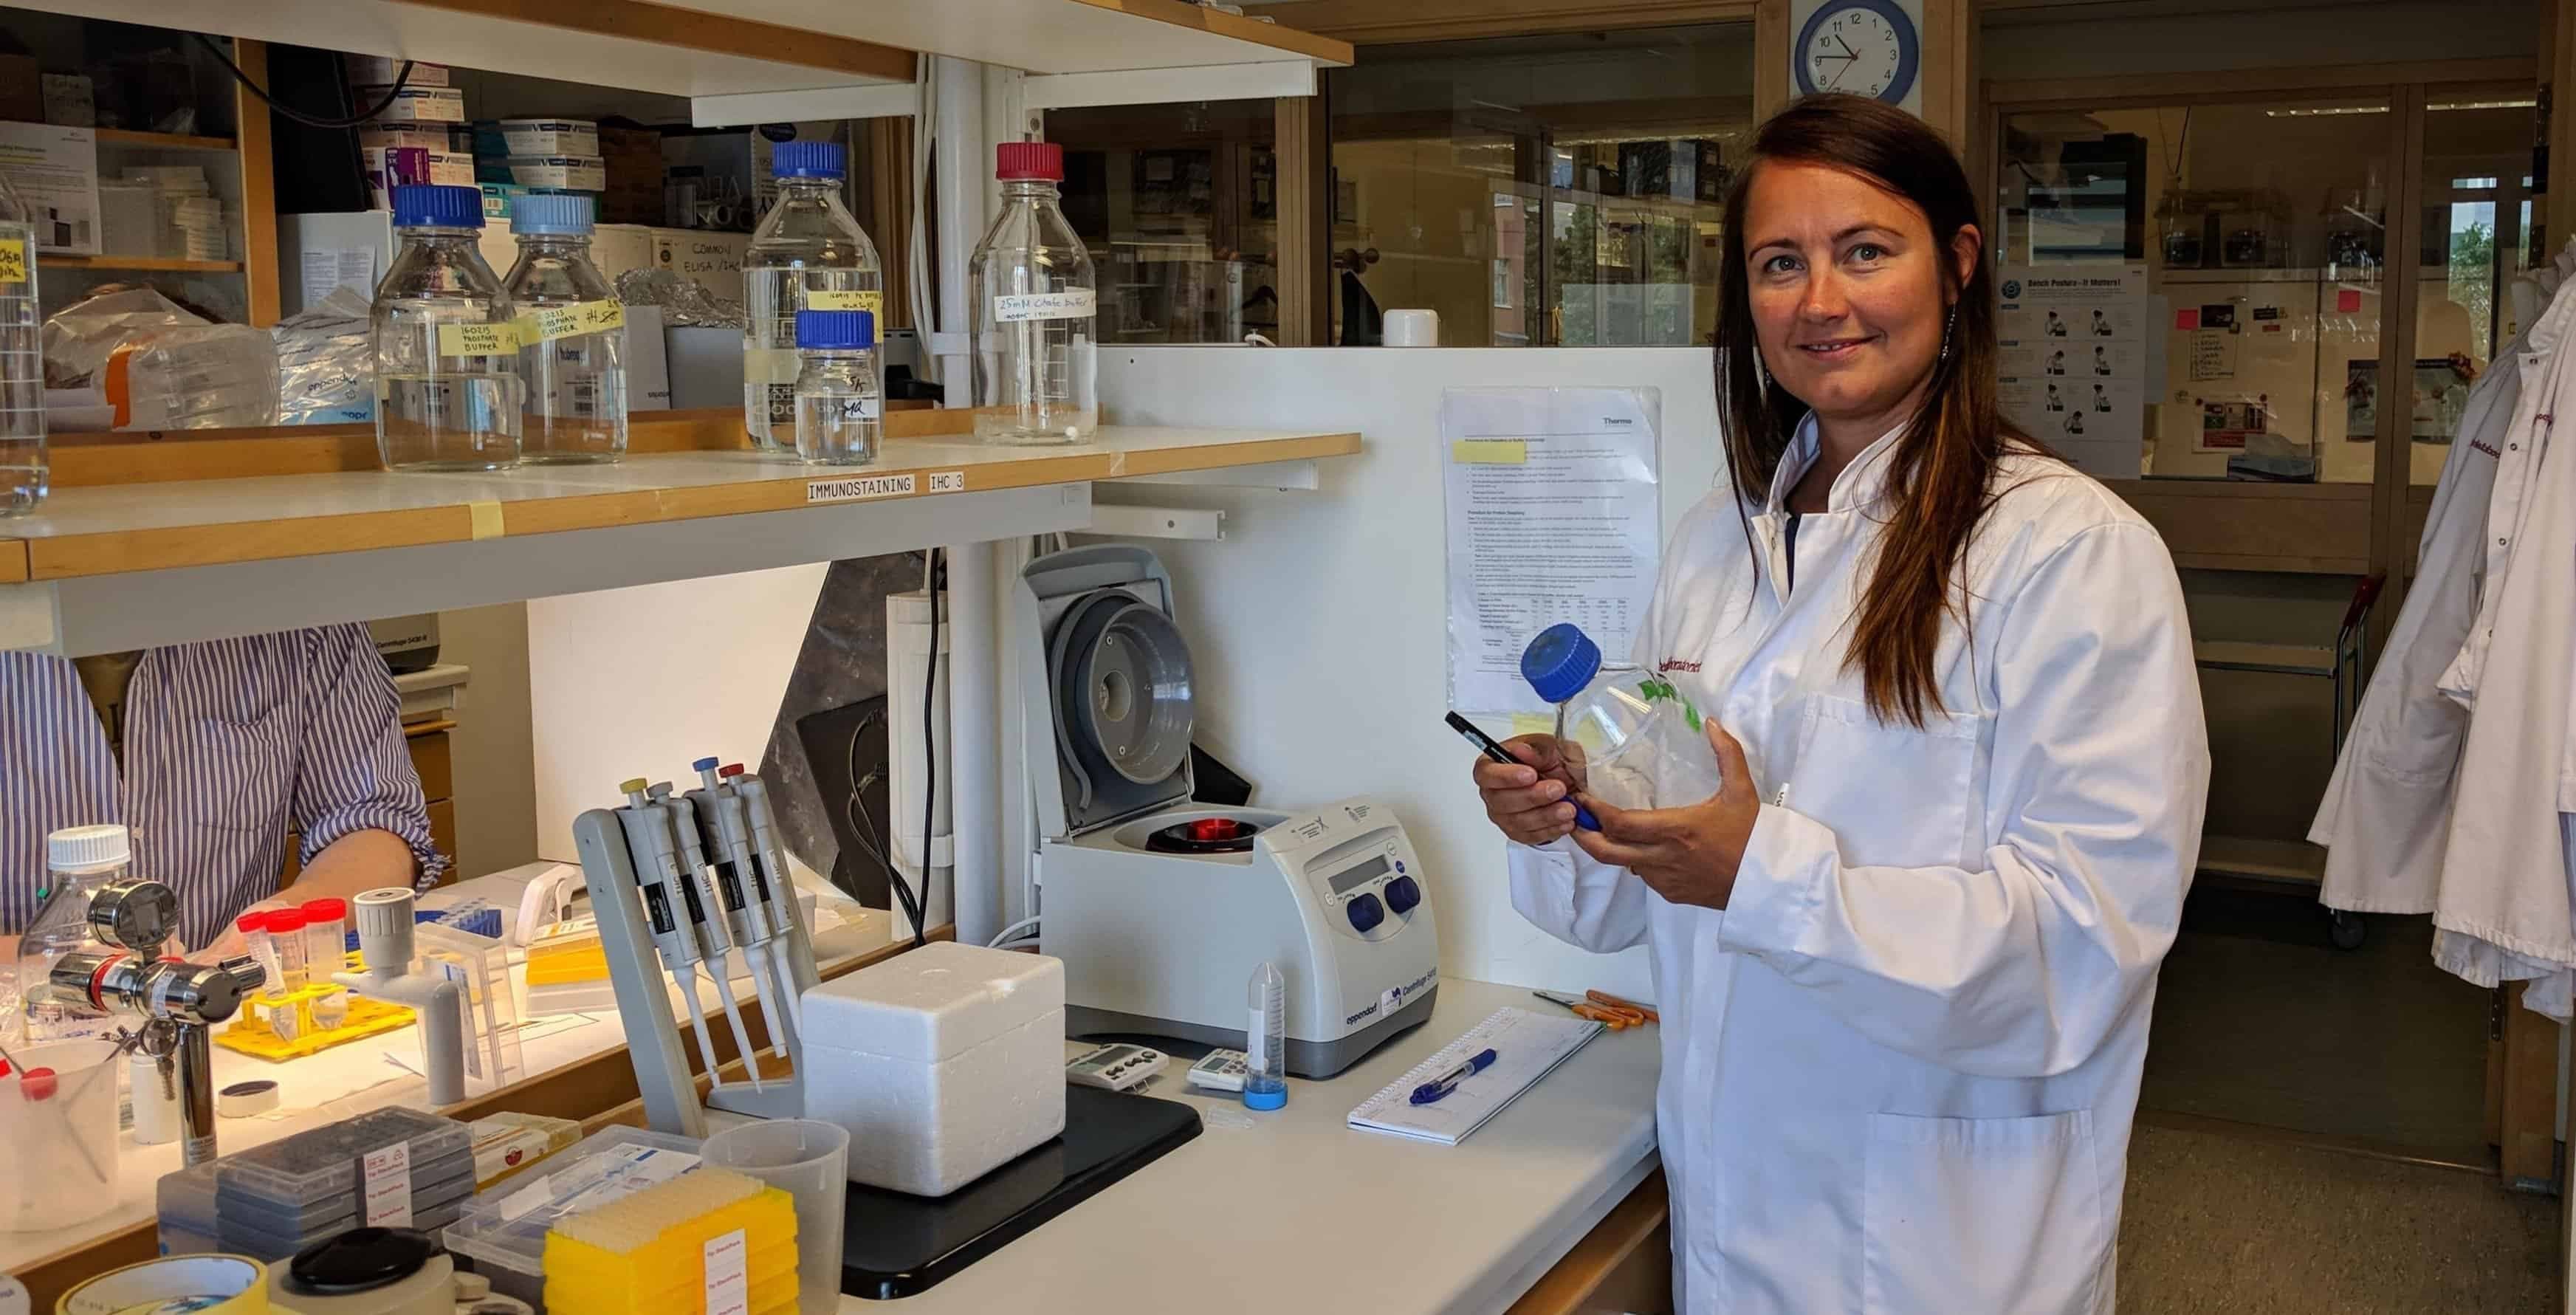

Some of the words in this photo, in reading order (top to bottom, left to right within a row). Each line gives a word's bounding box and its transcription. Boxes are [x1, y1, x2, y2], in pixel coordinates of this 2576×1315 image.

[1849, 13, 1861, 24] 12
[1872, 18, 1878, 29] 1
[1832, 21, 1842, 32] 11
[1885, 30, 1892, 41] 2
[1818, 36, 1830, 47] 10
[1890, 49, 1897, 61] 3
[1884, 69, 1891, 80] 4
[1820, 75, 1827, 86] 8
[1871, 84, 1878, 95] 5
[808, 477, 911, 500] IMMUNOSTAINING
[931, 475, 950, 490] IHC
[956, 474, 964, 488] 3
[1346, 1001, 1377, 1026] eppendorf
